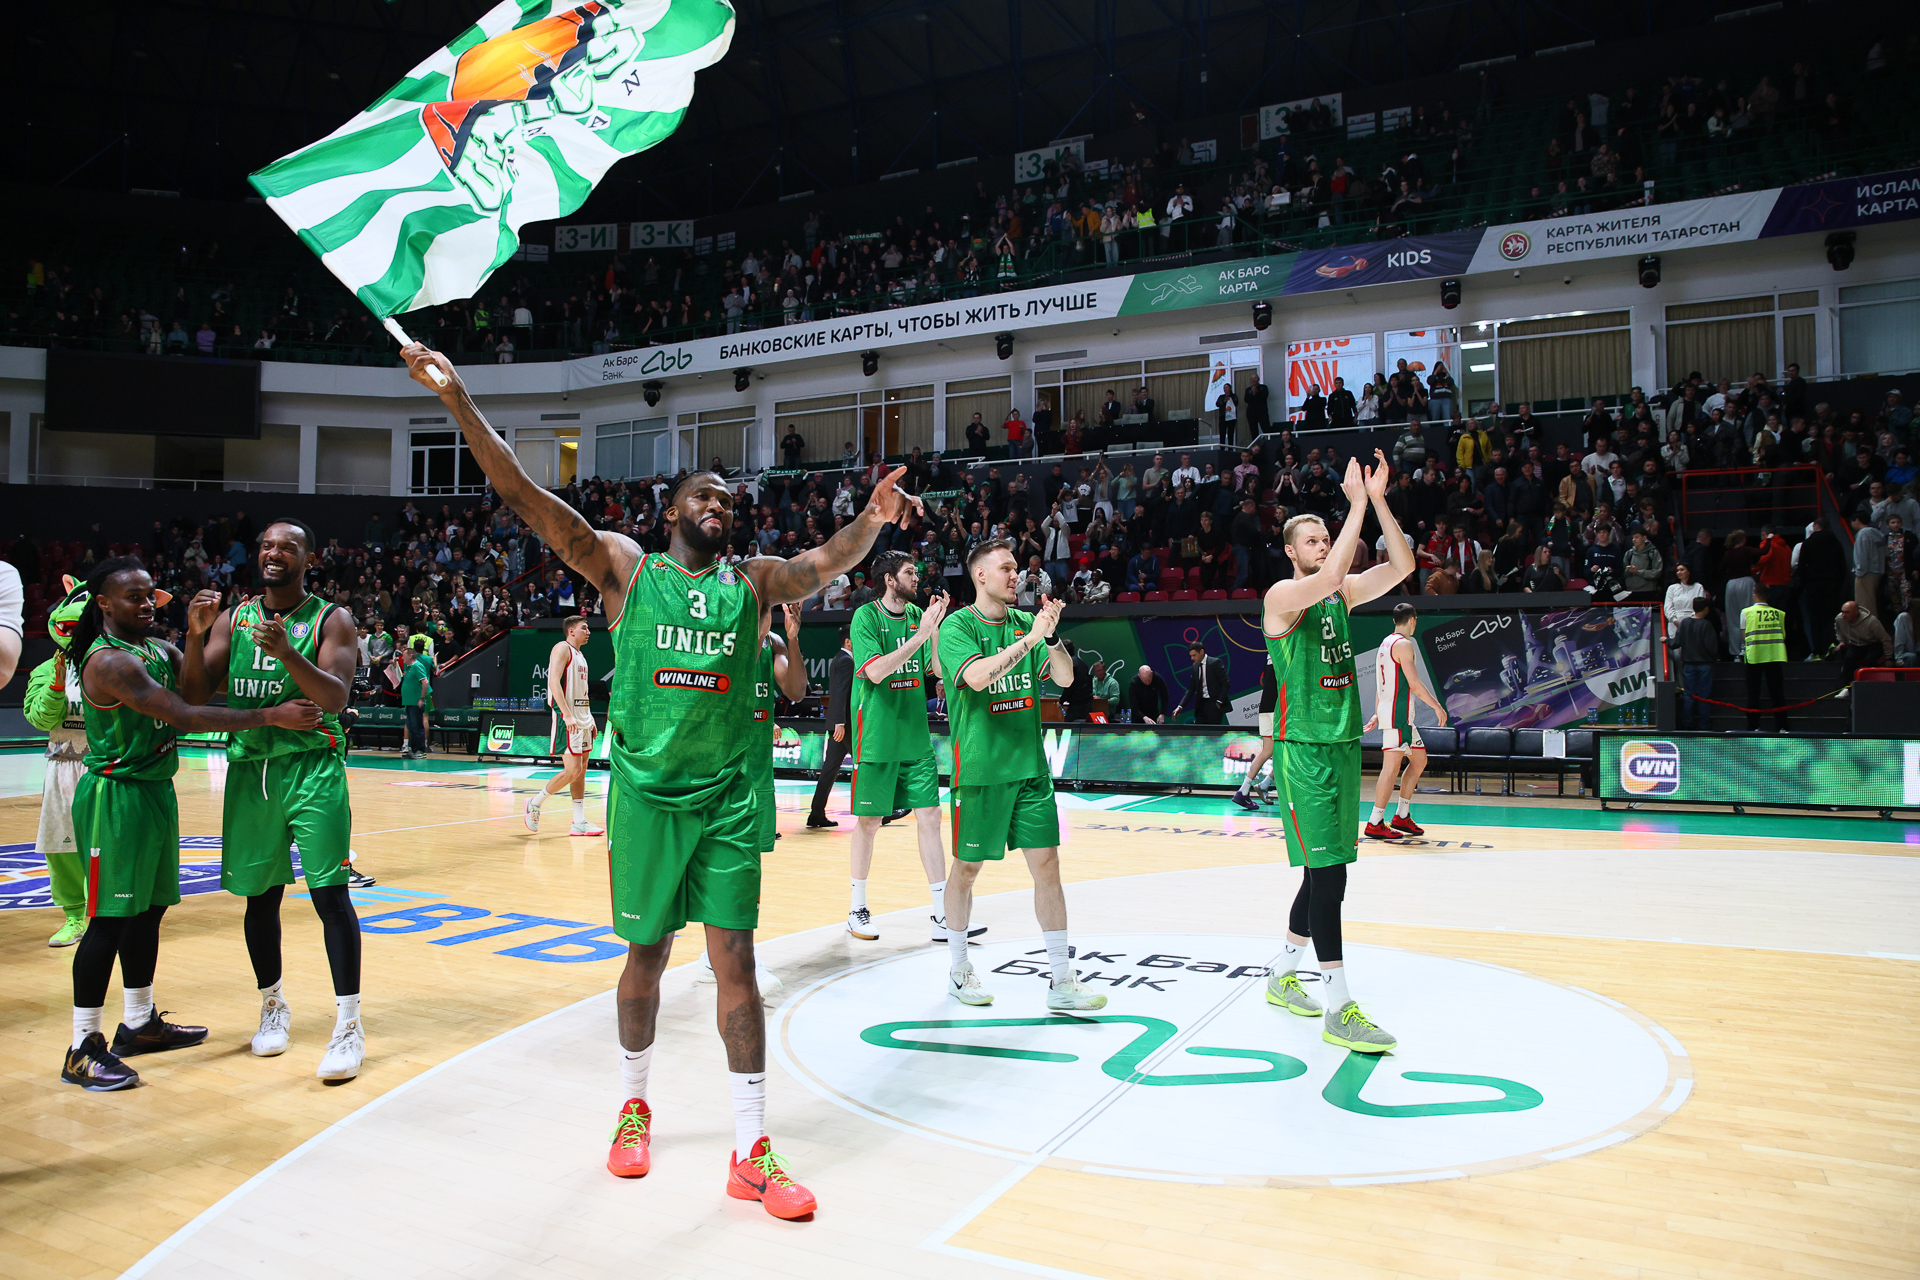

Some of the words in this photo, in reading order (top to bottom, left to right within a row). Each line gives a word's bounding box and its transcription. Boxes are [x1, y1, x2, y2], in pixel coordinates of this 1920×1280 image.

[1857, 197, 1919, 217] КАРТА
[1546, 223, 1593, 239] КАРТА
[1596, 215, 1661, 232] ЖИТЕЛЯ
[564, 226, 607, 250] 3-И
[1546, 232, 1649, 254] РЕСПУБЛИКИ
[1652, 220, 1741, 242] ТАТАРСТАН
[1387, 249, 1432, 268] KIDS
[1218, 269, 1236, 281] АК
[1238, 265, 1270, 279] БАРС
[1219, 281, 1258, 295] КАРТА
[719, 329, 826, 360] БАНКОВСКИЕ
[830, 321, 893, 344] КАРТЫ,
[897, 311, 960, 334] ЧТОБЫ
[965, 303, 1021, 325] ЖИТЬ
[1025, 292, 1098, 317] ЛУЧШЕ
[602, 356, 615, 368] Ак
[616, 355, 639, 368] Барс
[602, 370, 624, 381] Банк
[687, 587, 709, 620] 3
[1756, 609, 1781, 623] 7239
[1320, 615, 1337, 640] 21
[656, 624, 738, 657] UNICS
[1434, 634, 1446, 644] Ак
[1445, 628, 1466, 640] Барс
[1437, 641, 1457, 653] Банк
[233, 677, 286, 699] UNICS
[659, 672, 717, 688] WINLINE
[992, 699, 1025, 713] WINLINE
[443, 714, 460, 722] UNICS
[494, 728, 513, 740] WIN
[1635, 759, 1676, 776] WIN
[621, 911, 641, 921] MAXX
[359, 902, 679, 964] ВТБ
